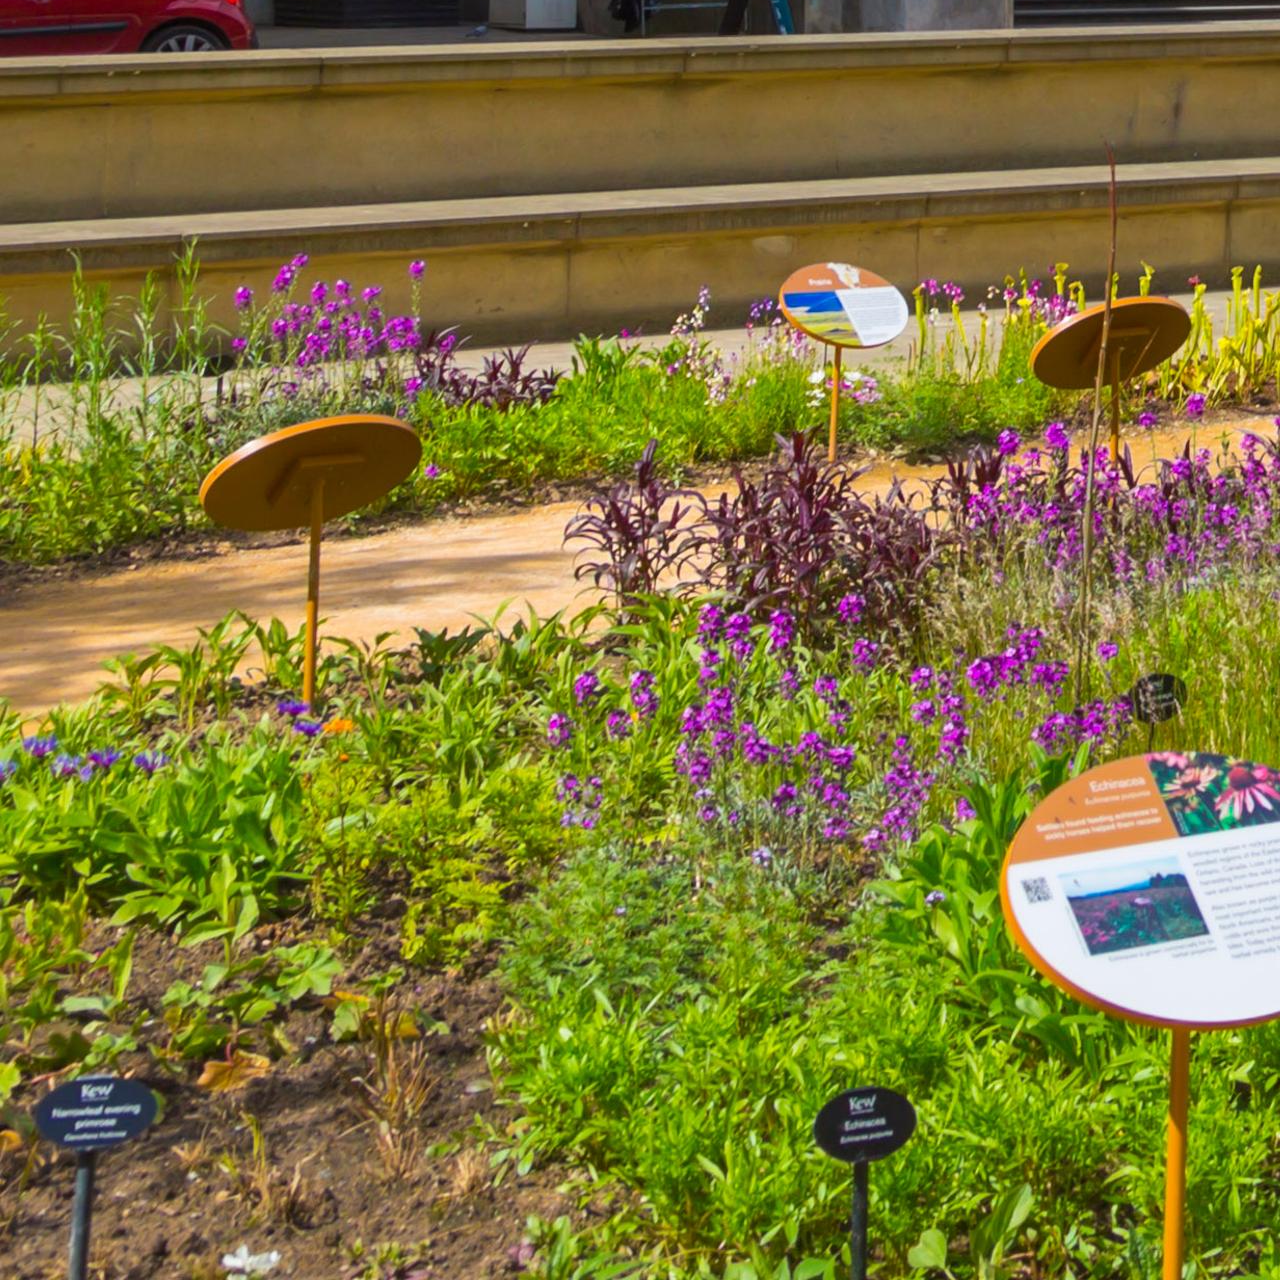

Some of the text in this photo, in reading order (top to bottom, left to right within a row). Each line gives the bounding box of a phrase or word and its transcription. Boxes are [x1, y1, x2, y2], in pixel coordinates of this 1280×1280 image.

[1088, 776, 1146, 792] Echinacea
[81, 1083, 114, 1098] Kew
[849, 1094, 876, 1110] Kew
[52, 1104, 141, 1118] Narrowleaf evening
[75, 1118, 117, 1130] primrose
[844, 1117, 886, 1131] Echinacea
